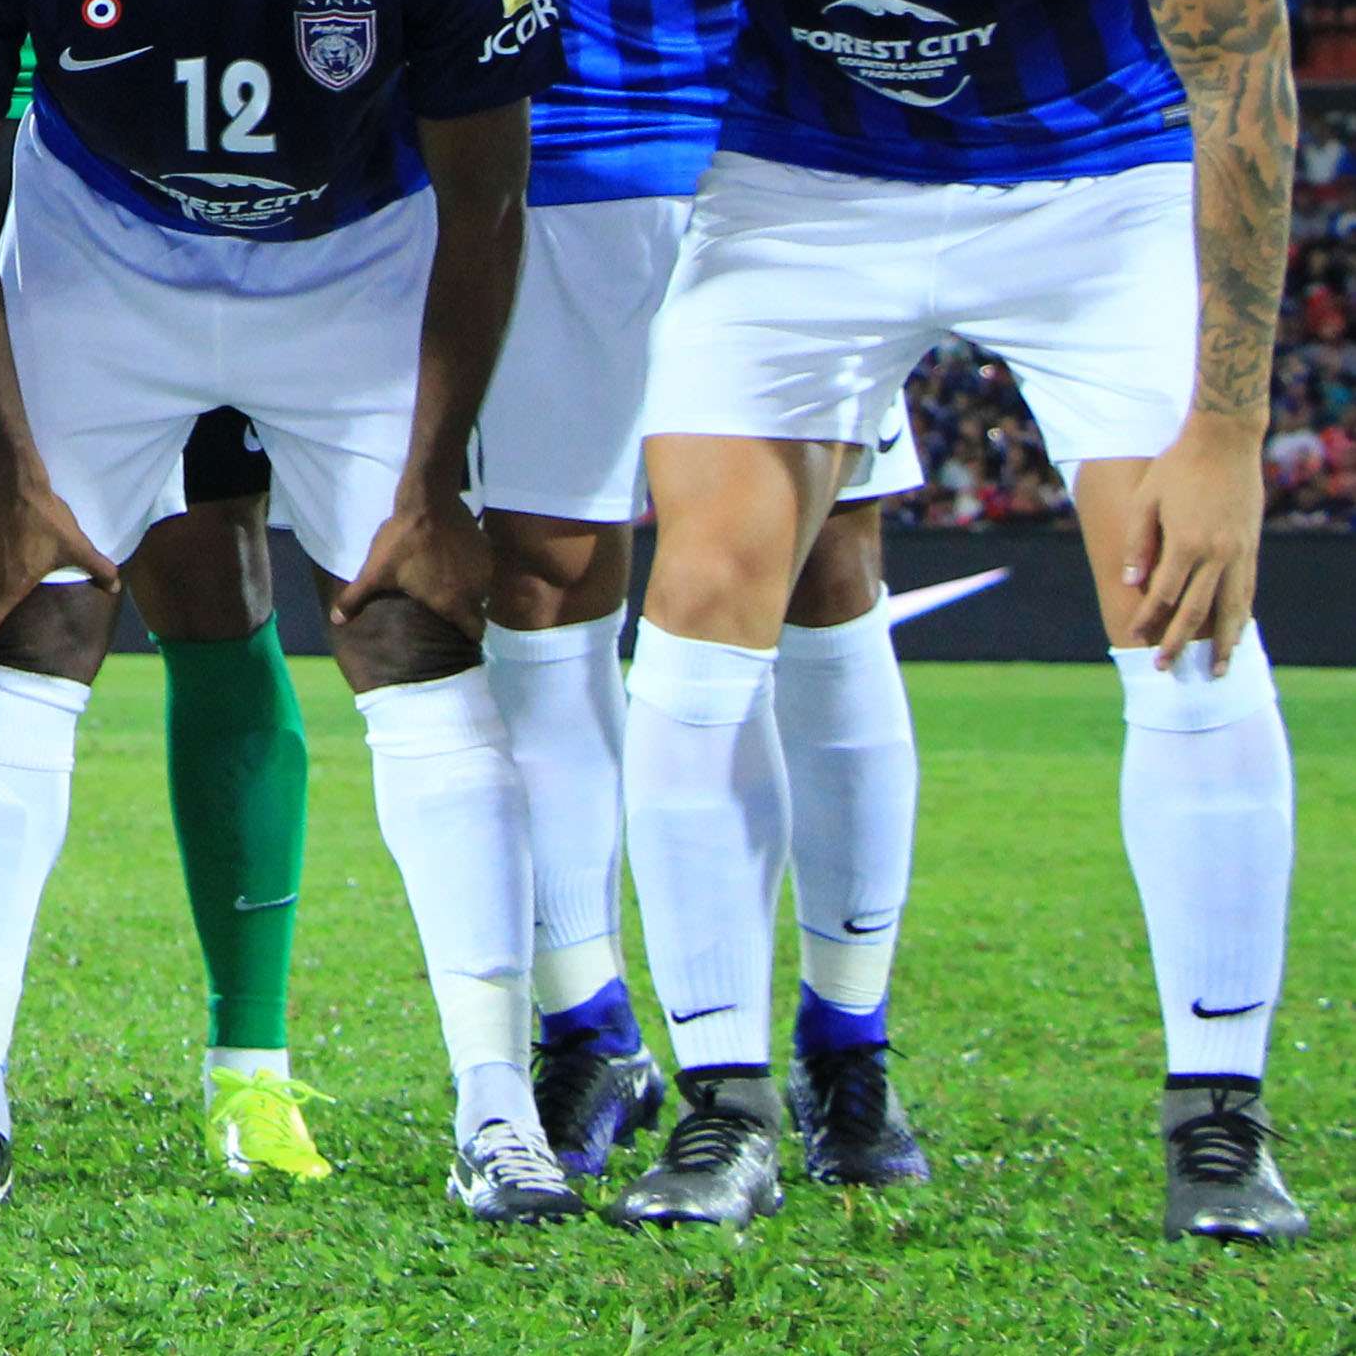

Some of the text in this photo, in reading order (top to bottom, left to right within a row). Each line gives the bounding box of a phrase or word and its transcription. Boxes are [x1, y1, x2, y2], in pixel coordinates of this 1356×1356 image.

[790, 22, 998, 60] FOREST CITY
[174, 57, 277, 154] 12
[252, 182, 330, 213] CITY
